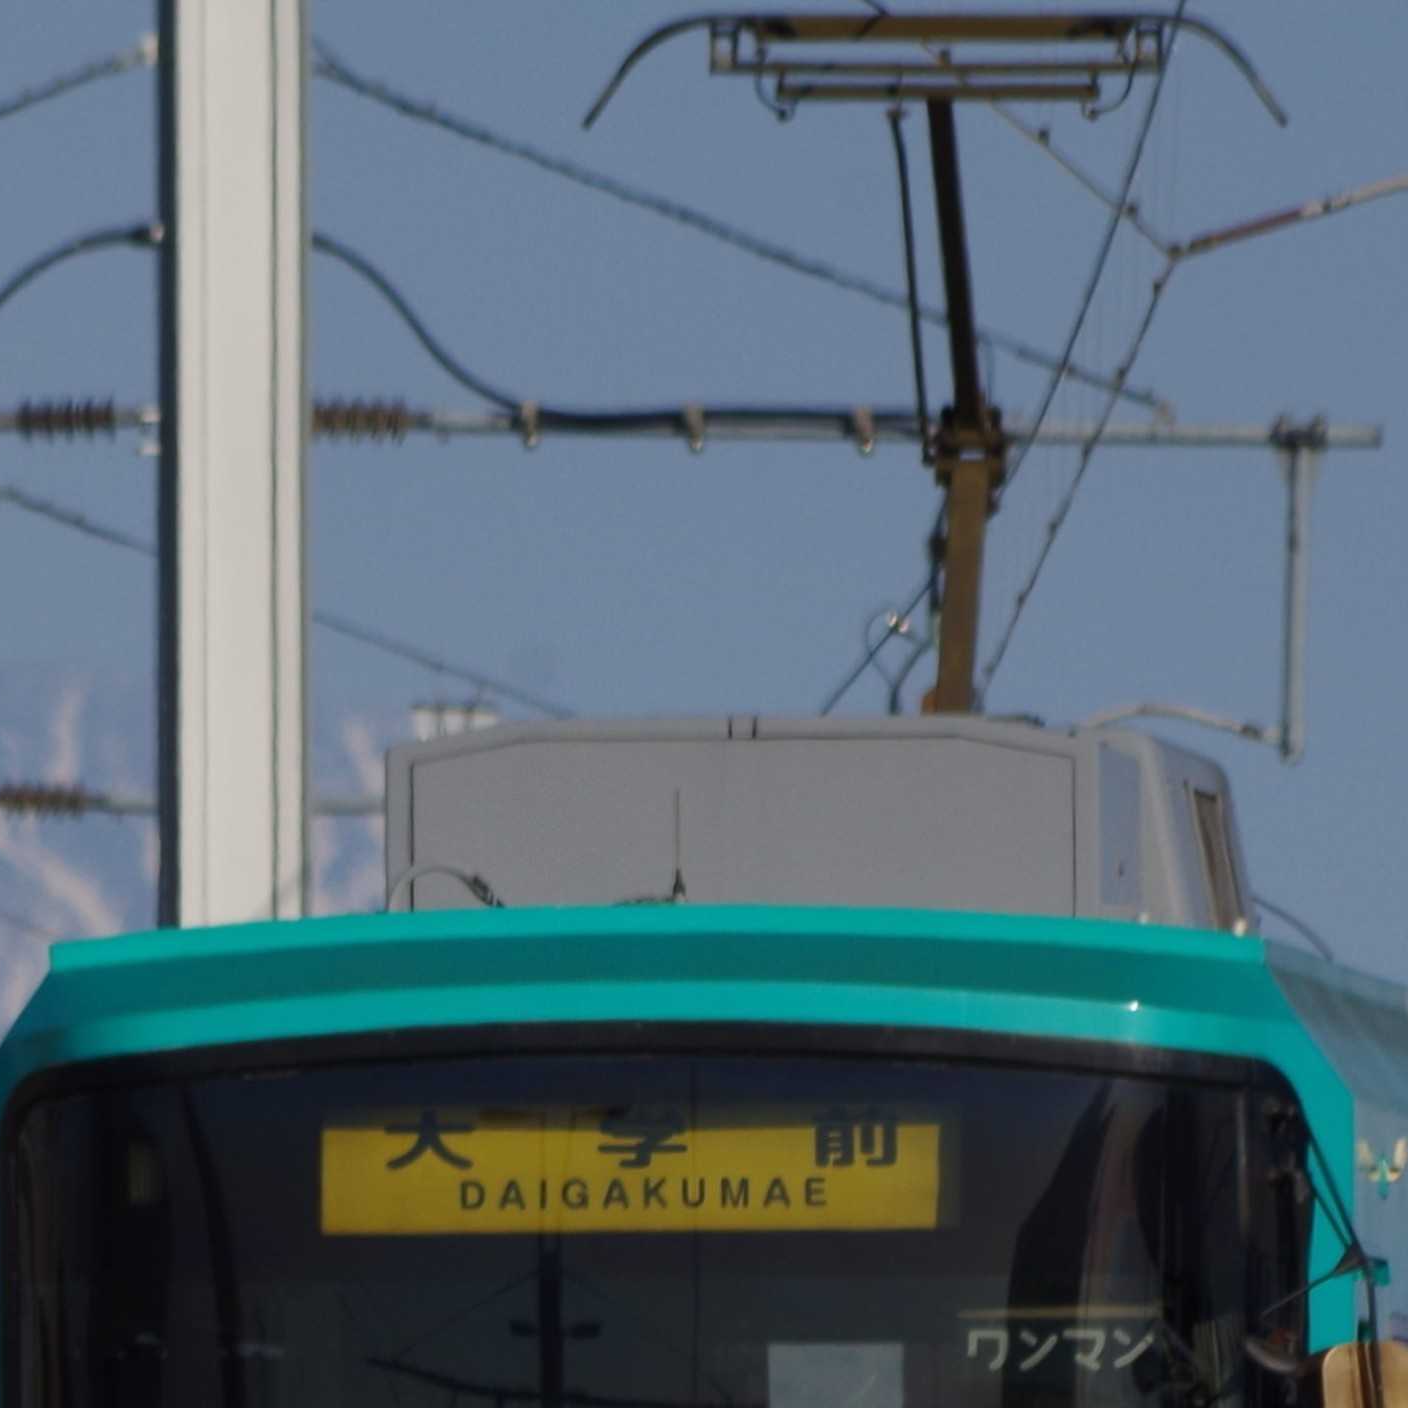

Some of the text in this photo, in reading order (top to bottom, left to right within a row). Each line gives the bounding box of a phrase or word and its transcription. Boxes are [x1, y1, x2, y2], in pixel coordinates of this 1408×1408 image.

[459, 1178, 829, 1211] DAIGAKUMAE
[968, 1330, 1155, 1370] ワンマン
